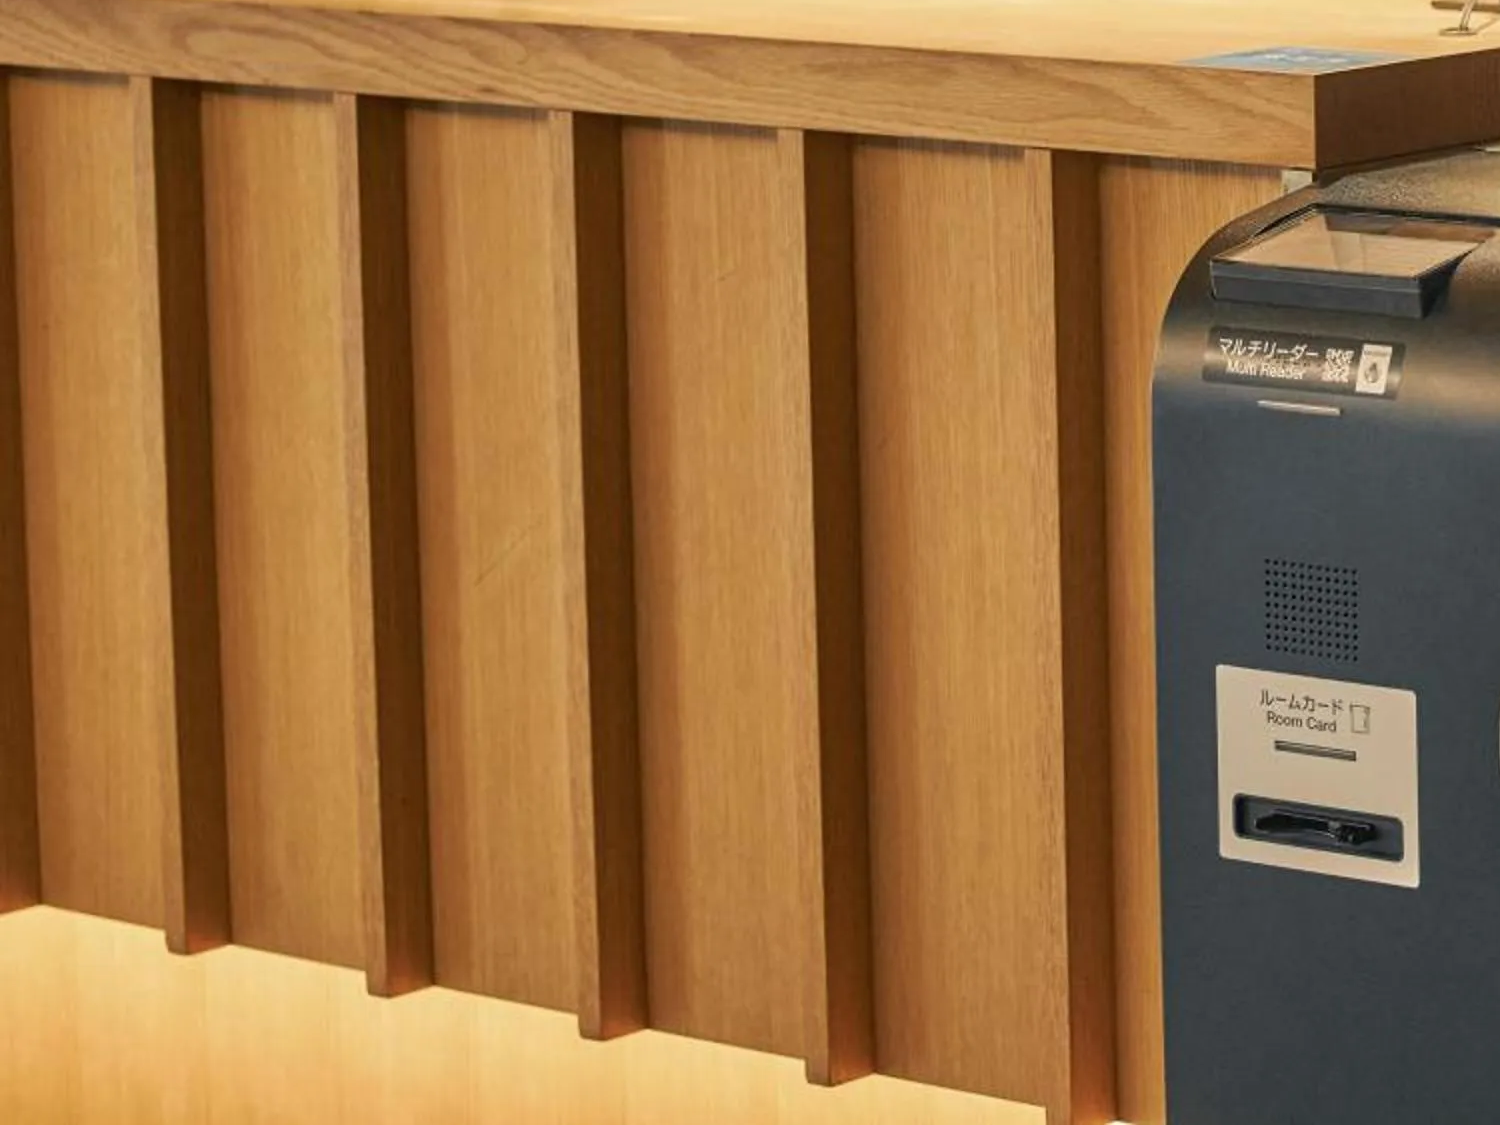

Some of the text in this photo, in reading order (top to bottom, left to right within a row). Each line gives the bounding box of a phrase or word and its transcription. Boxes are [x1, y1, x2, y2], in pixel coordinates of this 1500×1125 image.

[1219, 338, 1319, 362] マルチリーダー
[1260, 361, 1305, 380] Reader
[1259, 688, 1345, 716] ルームカード
[1266, 711, 1338, 733] Room Card
